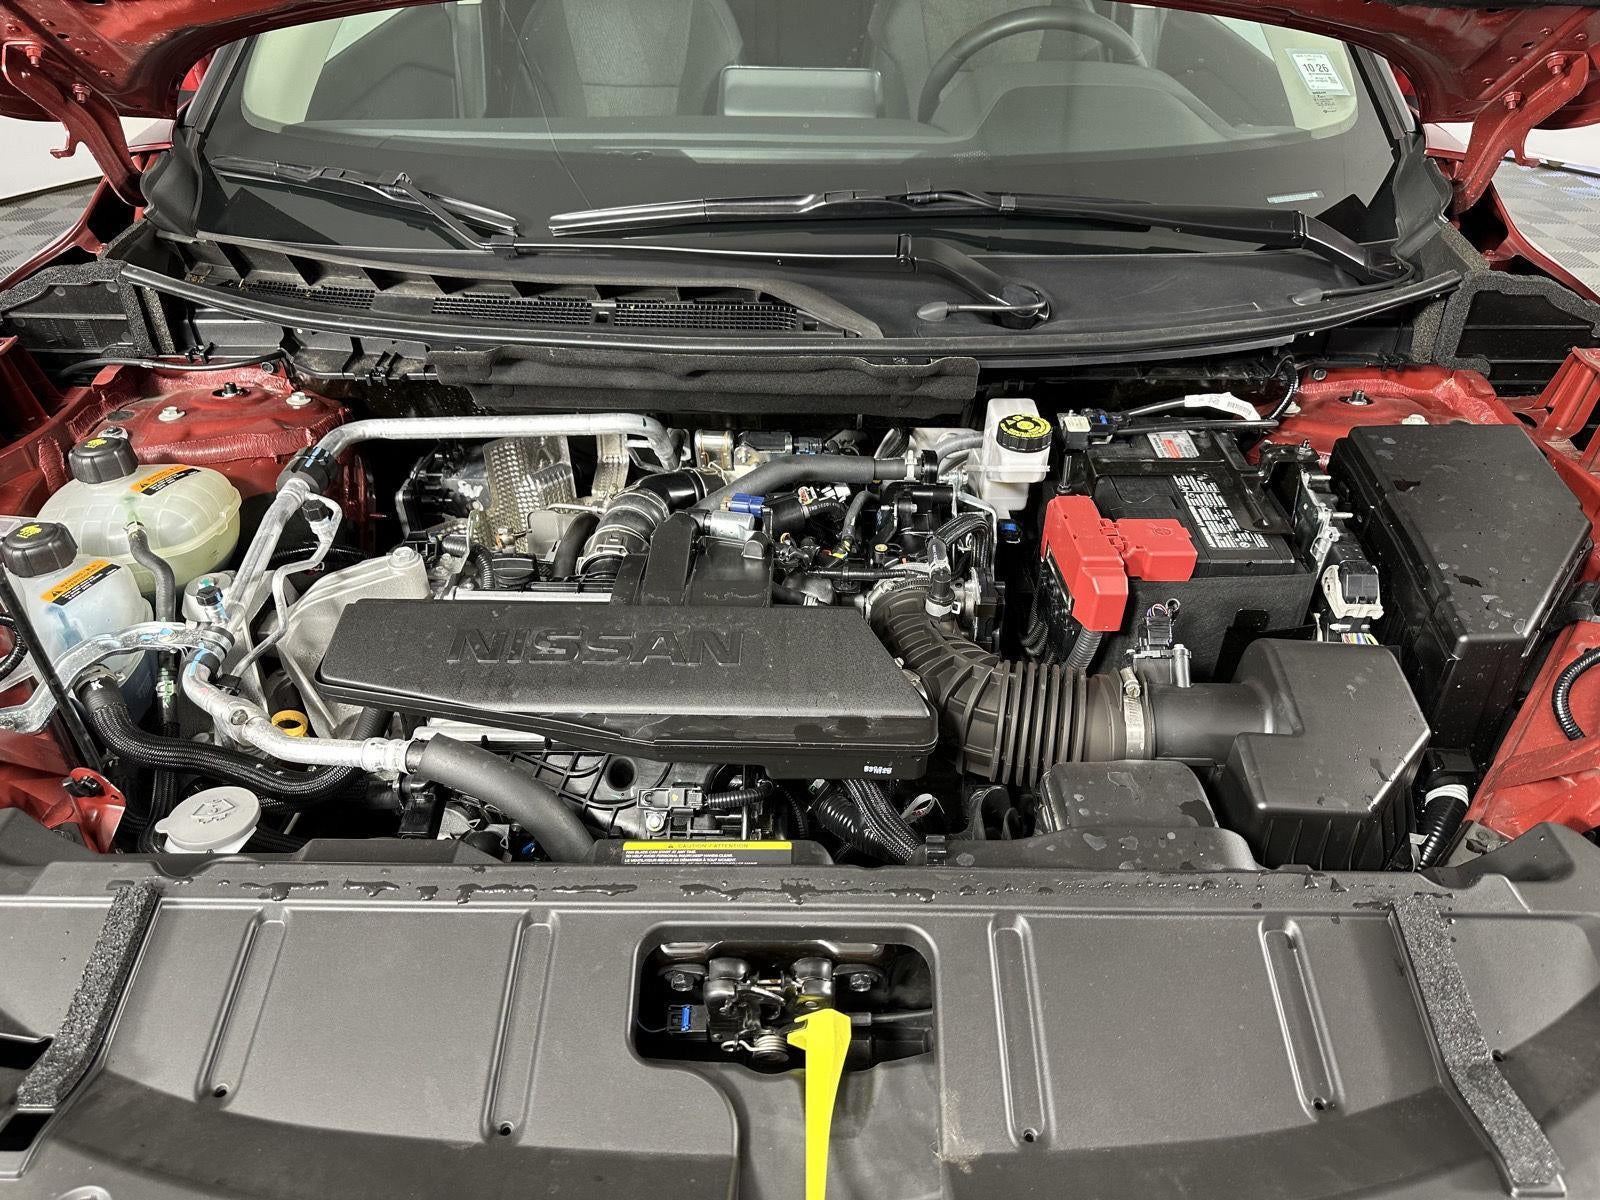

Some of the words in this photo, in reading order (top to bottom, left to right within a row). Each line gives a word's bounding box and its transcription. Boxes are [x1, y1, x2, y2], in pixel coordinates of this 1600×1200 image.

[1303, 63, 1315, 72] 10
[1315, 63, 1329, 72] 26
[447, 628, 744, 666] NISSAN
